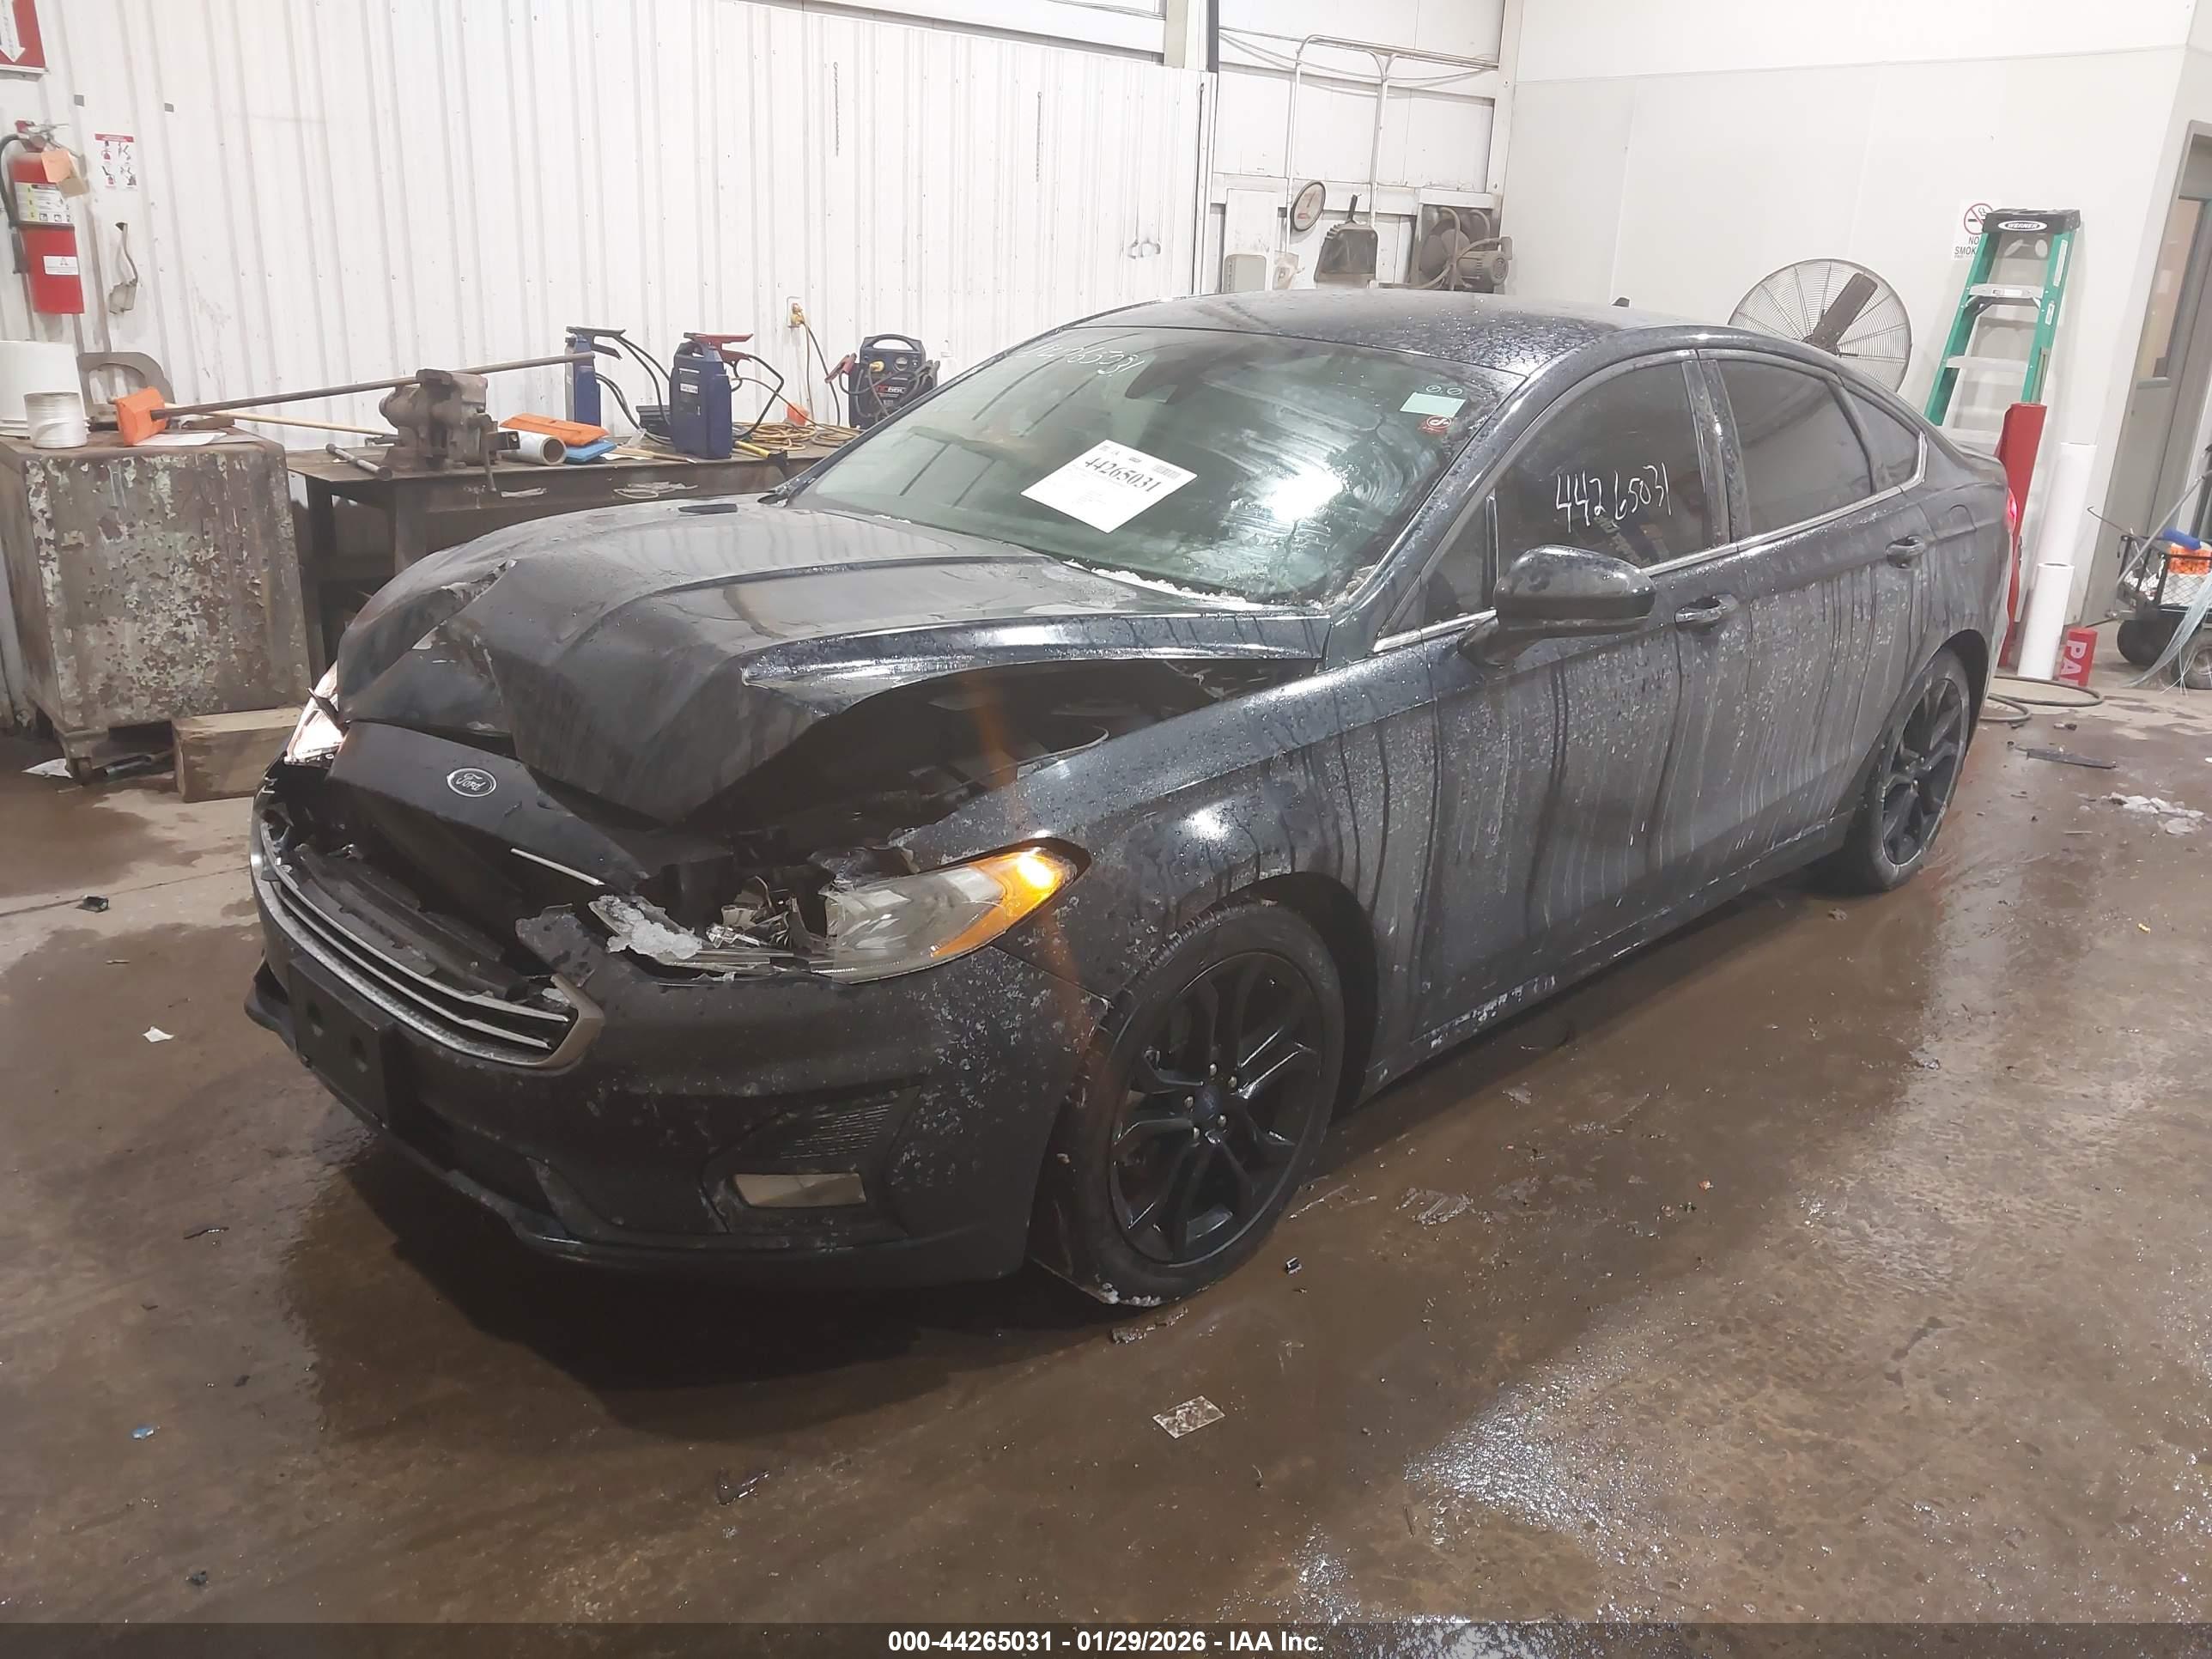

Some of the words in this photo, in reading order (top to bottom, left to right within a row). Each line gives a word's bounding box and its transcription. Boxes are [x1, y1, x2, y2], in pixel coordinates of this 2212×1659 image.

[1968, 235, 1980, 246] NO
[1954, 246, 1977, 255] SMOK
[1085, 457, 1162, 492] 44265031
[455, 773, 487, 792] Ford
